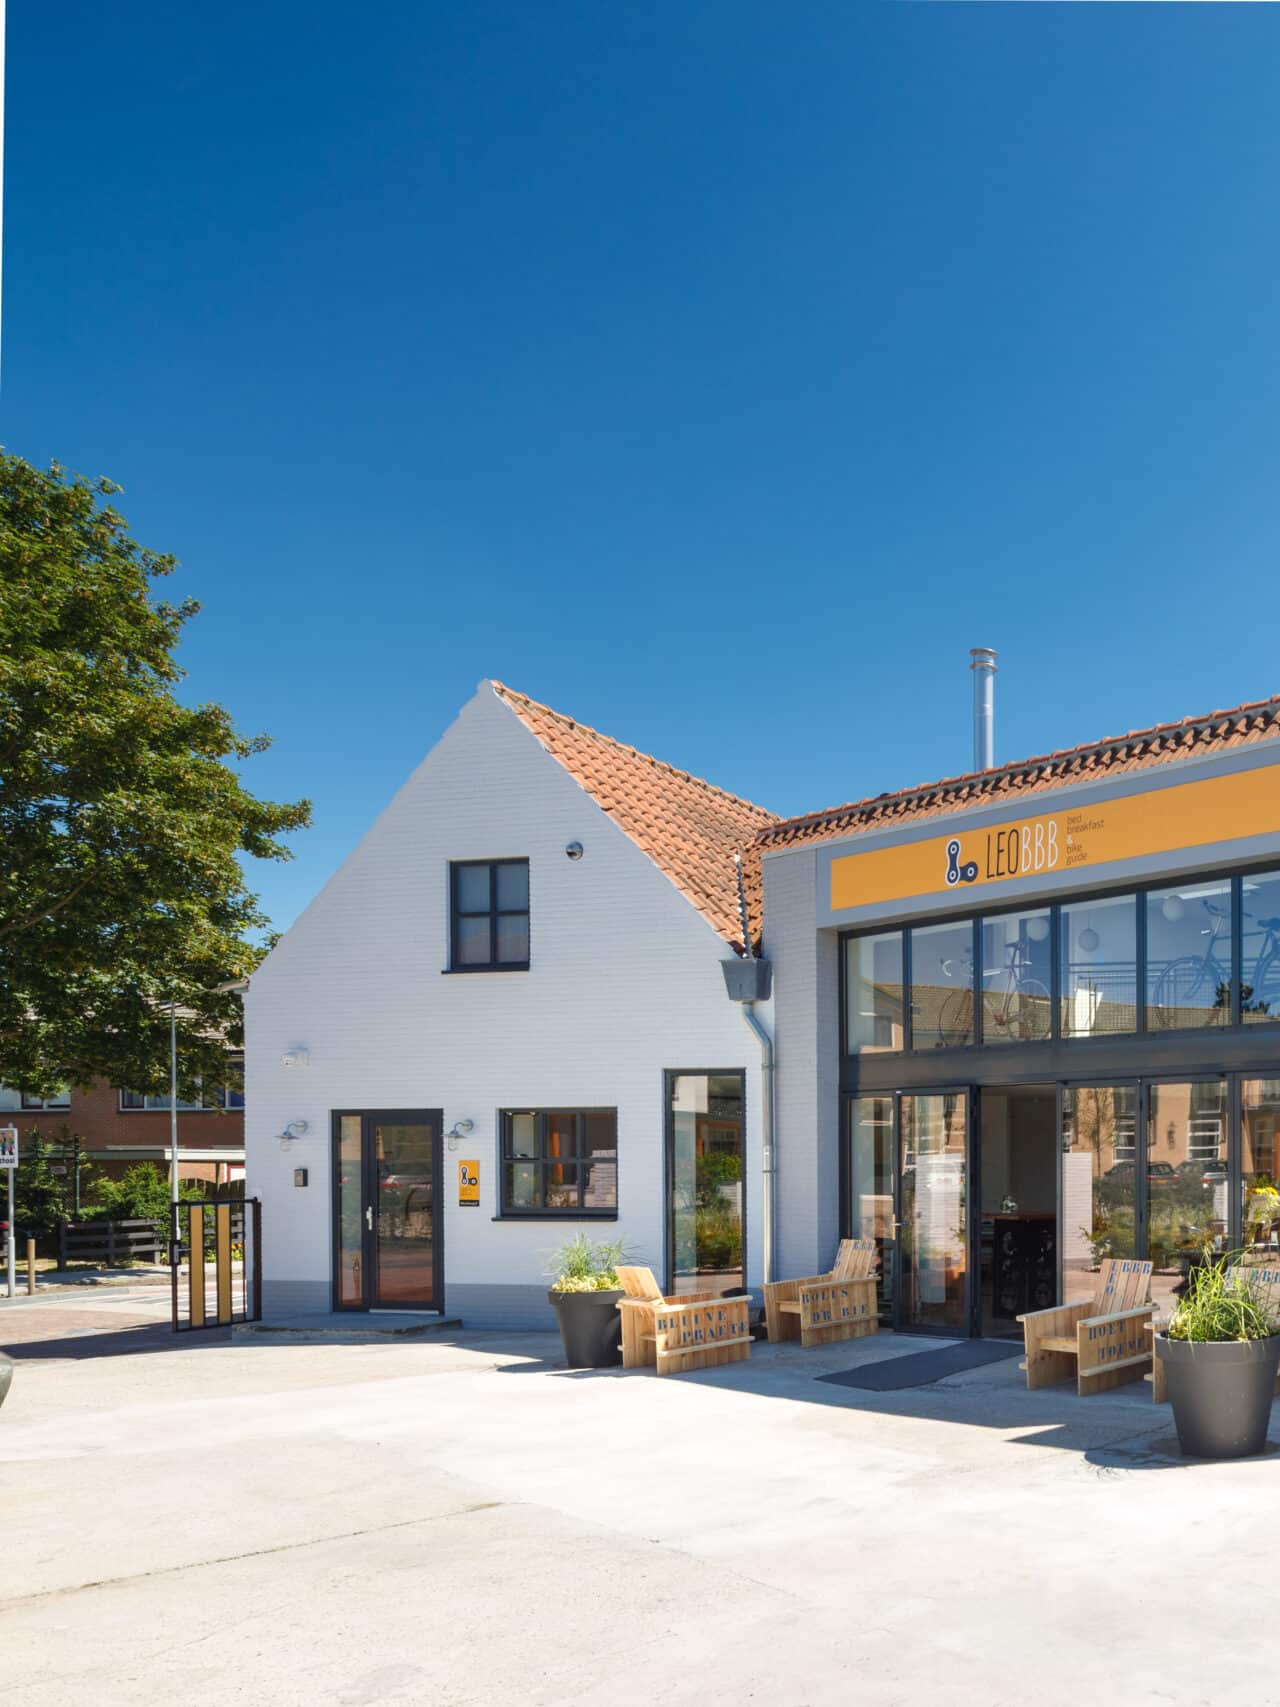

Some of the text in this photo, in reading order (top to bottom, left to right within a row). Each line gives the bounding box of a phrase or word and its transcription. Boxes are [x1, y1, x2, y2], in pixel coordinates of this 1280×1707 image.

[1066, 814, 1082, 825] bed
[1066, 819, 1105, 835] breakfast
[1066, 843, 1083, 854] bike
[1066, 852, 1088, 866] guide
[1122, 1262, 1151, 1274] BBB
